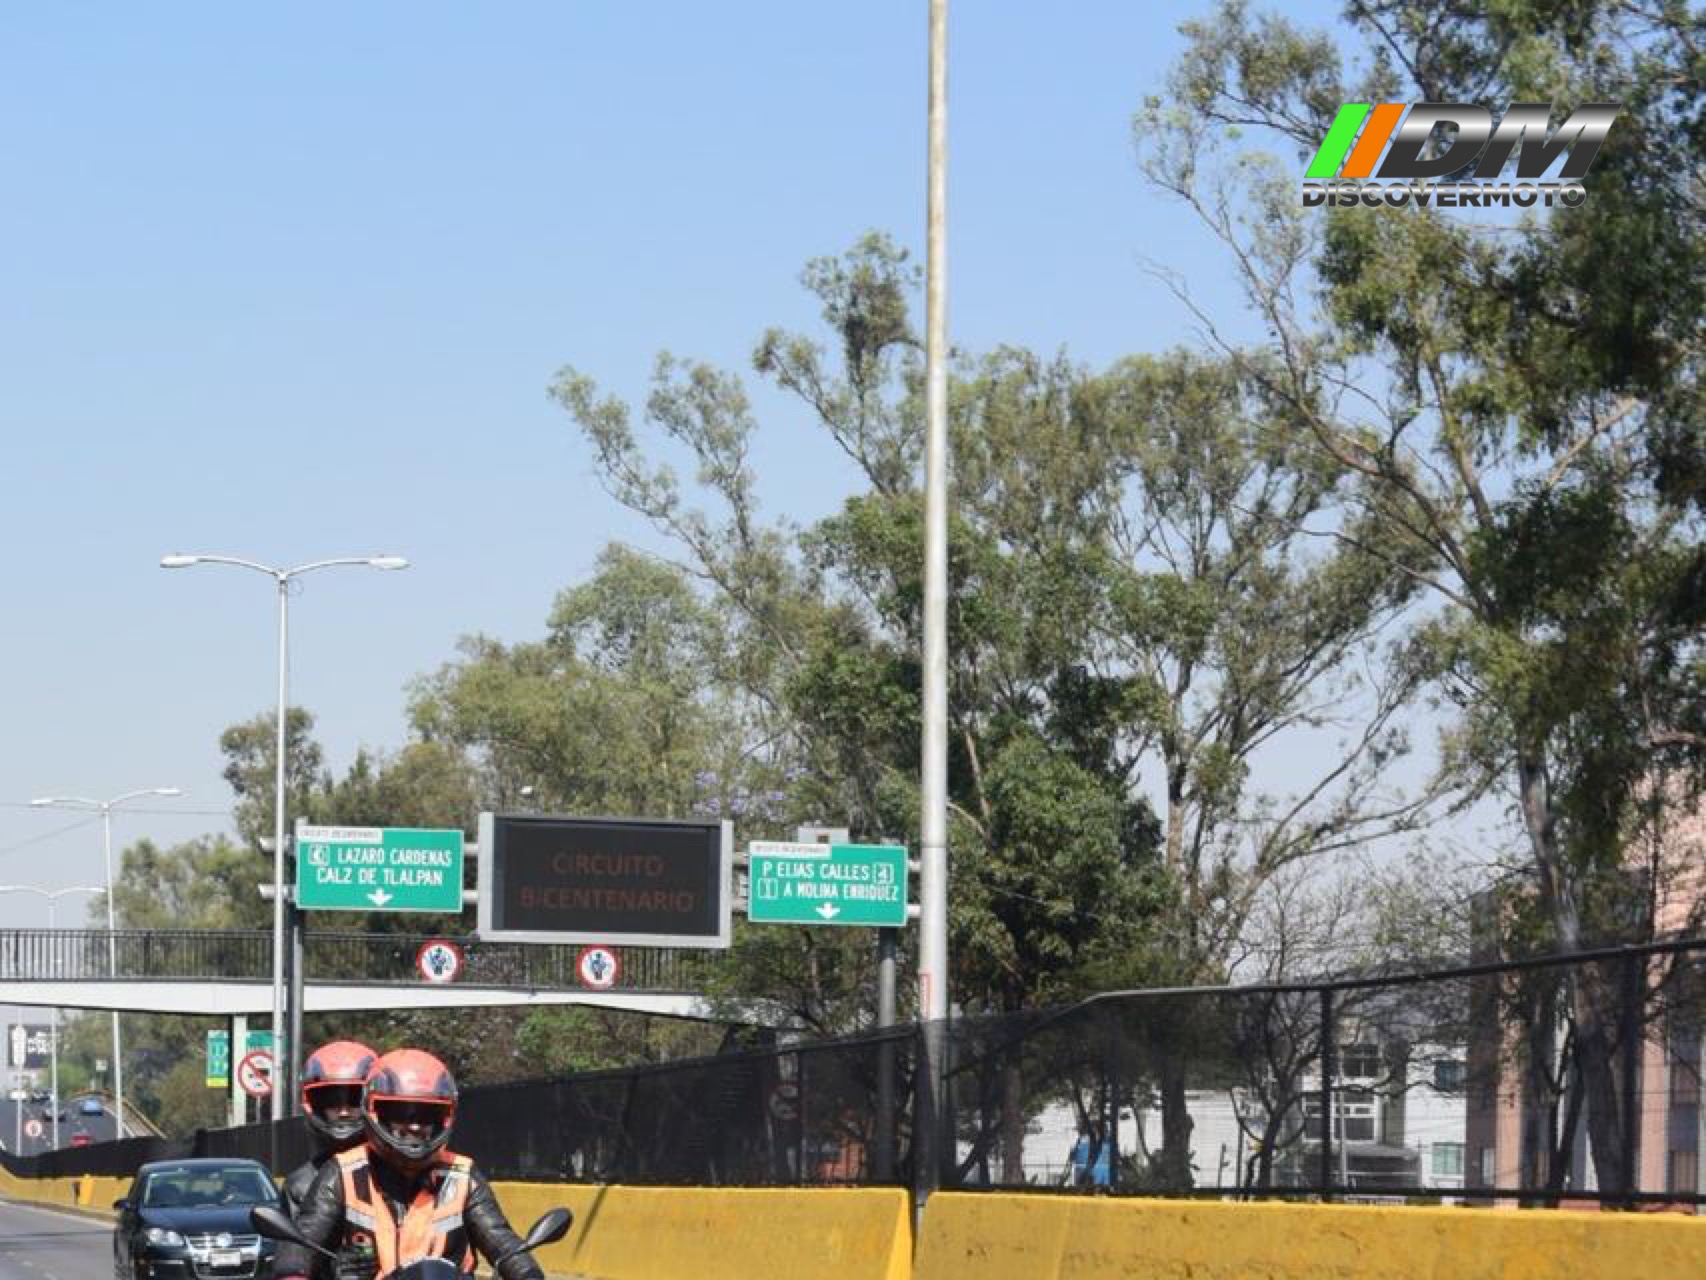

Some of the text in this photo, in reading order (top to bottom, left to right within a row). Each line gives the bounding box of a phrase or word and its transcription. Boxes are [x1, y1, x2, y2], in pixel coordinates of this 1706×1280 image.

[337, 847, 385, 865] LAZARO
[389, 848, 453, 866] CARDENAS
[553, 852, 665, 877] CIRCUITO
[316, 867, 443, 886] CALZ DE TLALPAN
[776, 862, 814, 879] ELIAS
[819, 863, 869, 881] CALLES
[519, 886, 696, 912] BICENTENARIO
[797, 881, 839, 899] MOLINA
